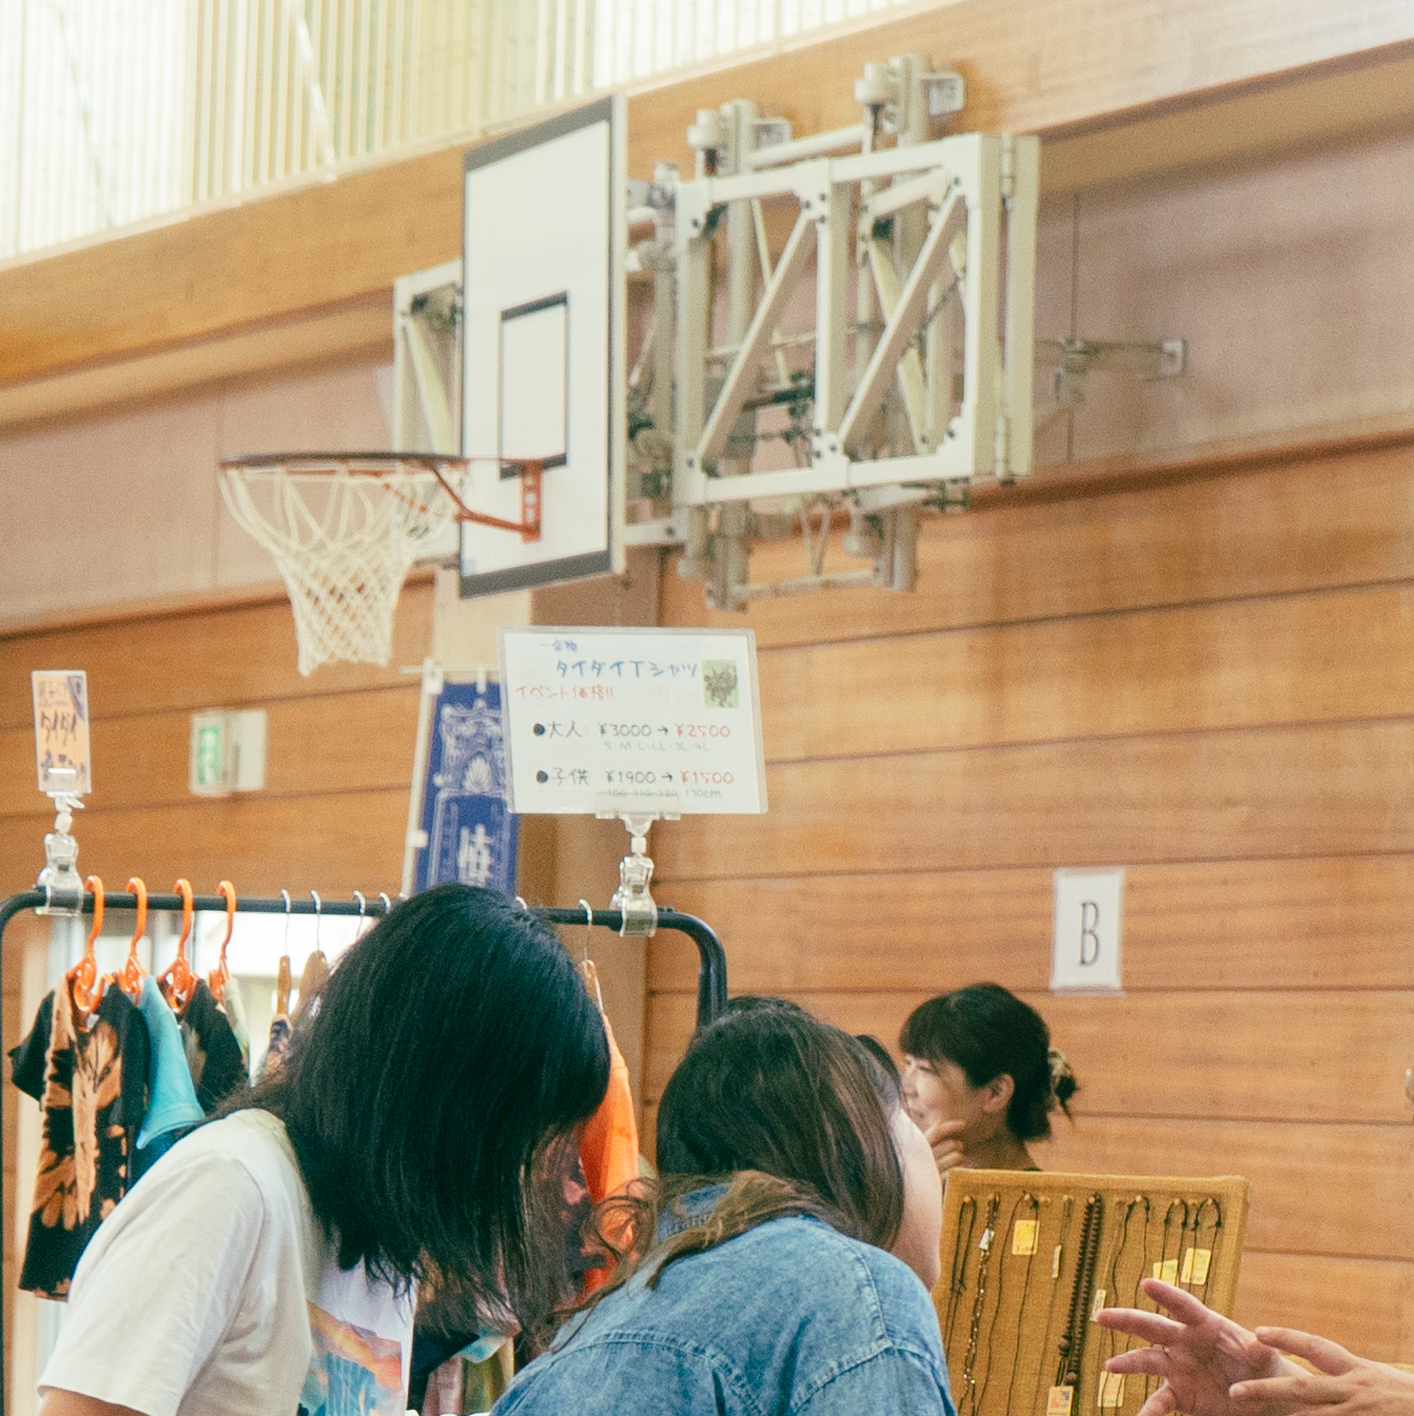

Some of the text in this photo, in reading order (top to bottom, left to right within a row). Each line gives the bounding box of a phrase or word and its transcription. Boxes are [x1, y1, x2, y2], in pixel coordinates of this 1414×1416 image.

[555, 659, 698, 679] タイダイTシャツ
[597, 723, 653, 738] ¥3000
[675, 724, 731, 739] ¥2500
[604, 770, 657, 785] ¥1900
[680, 770, 735, 785] ¥1500
[1080, 901, 1100, 966] B
